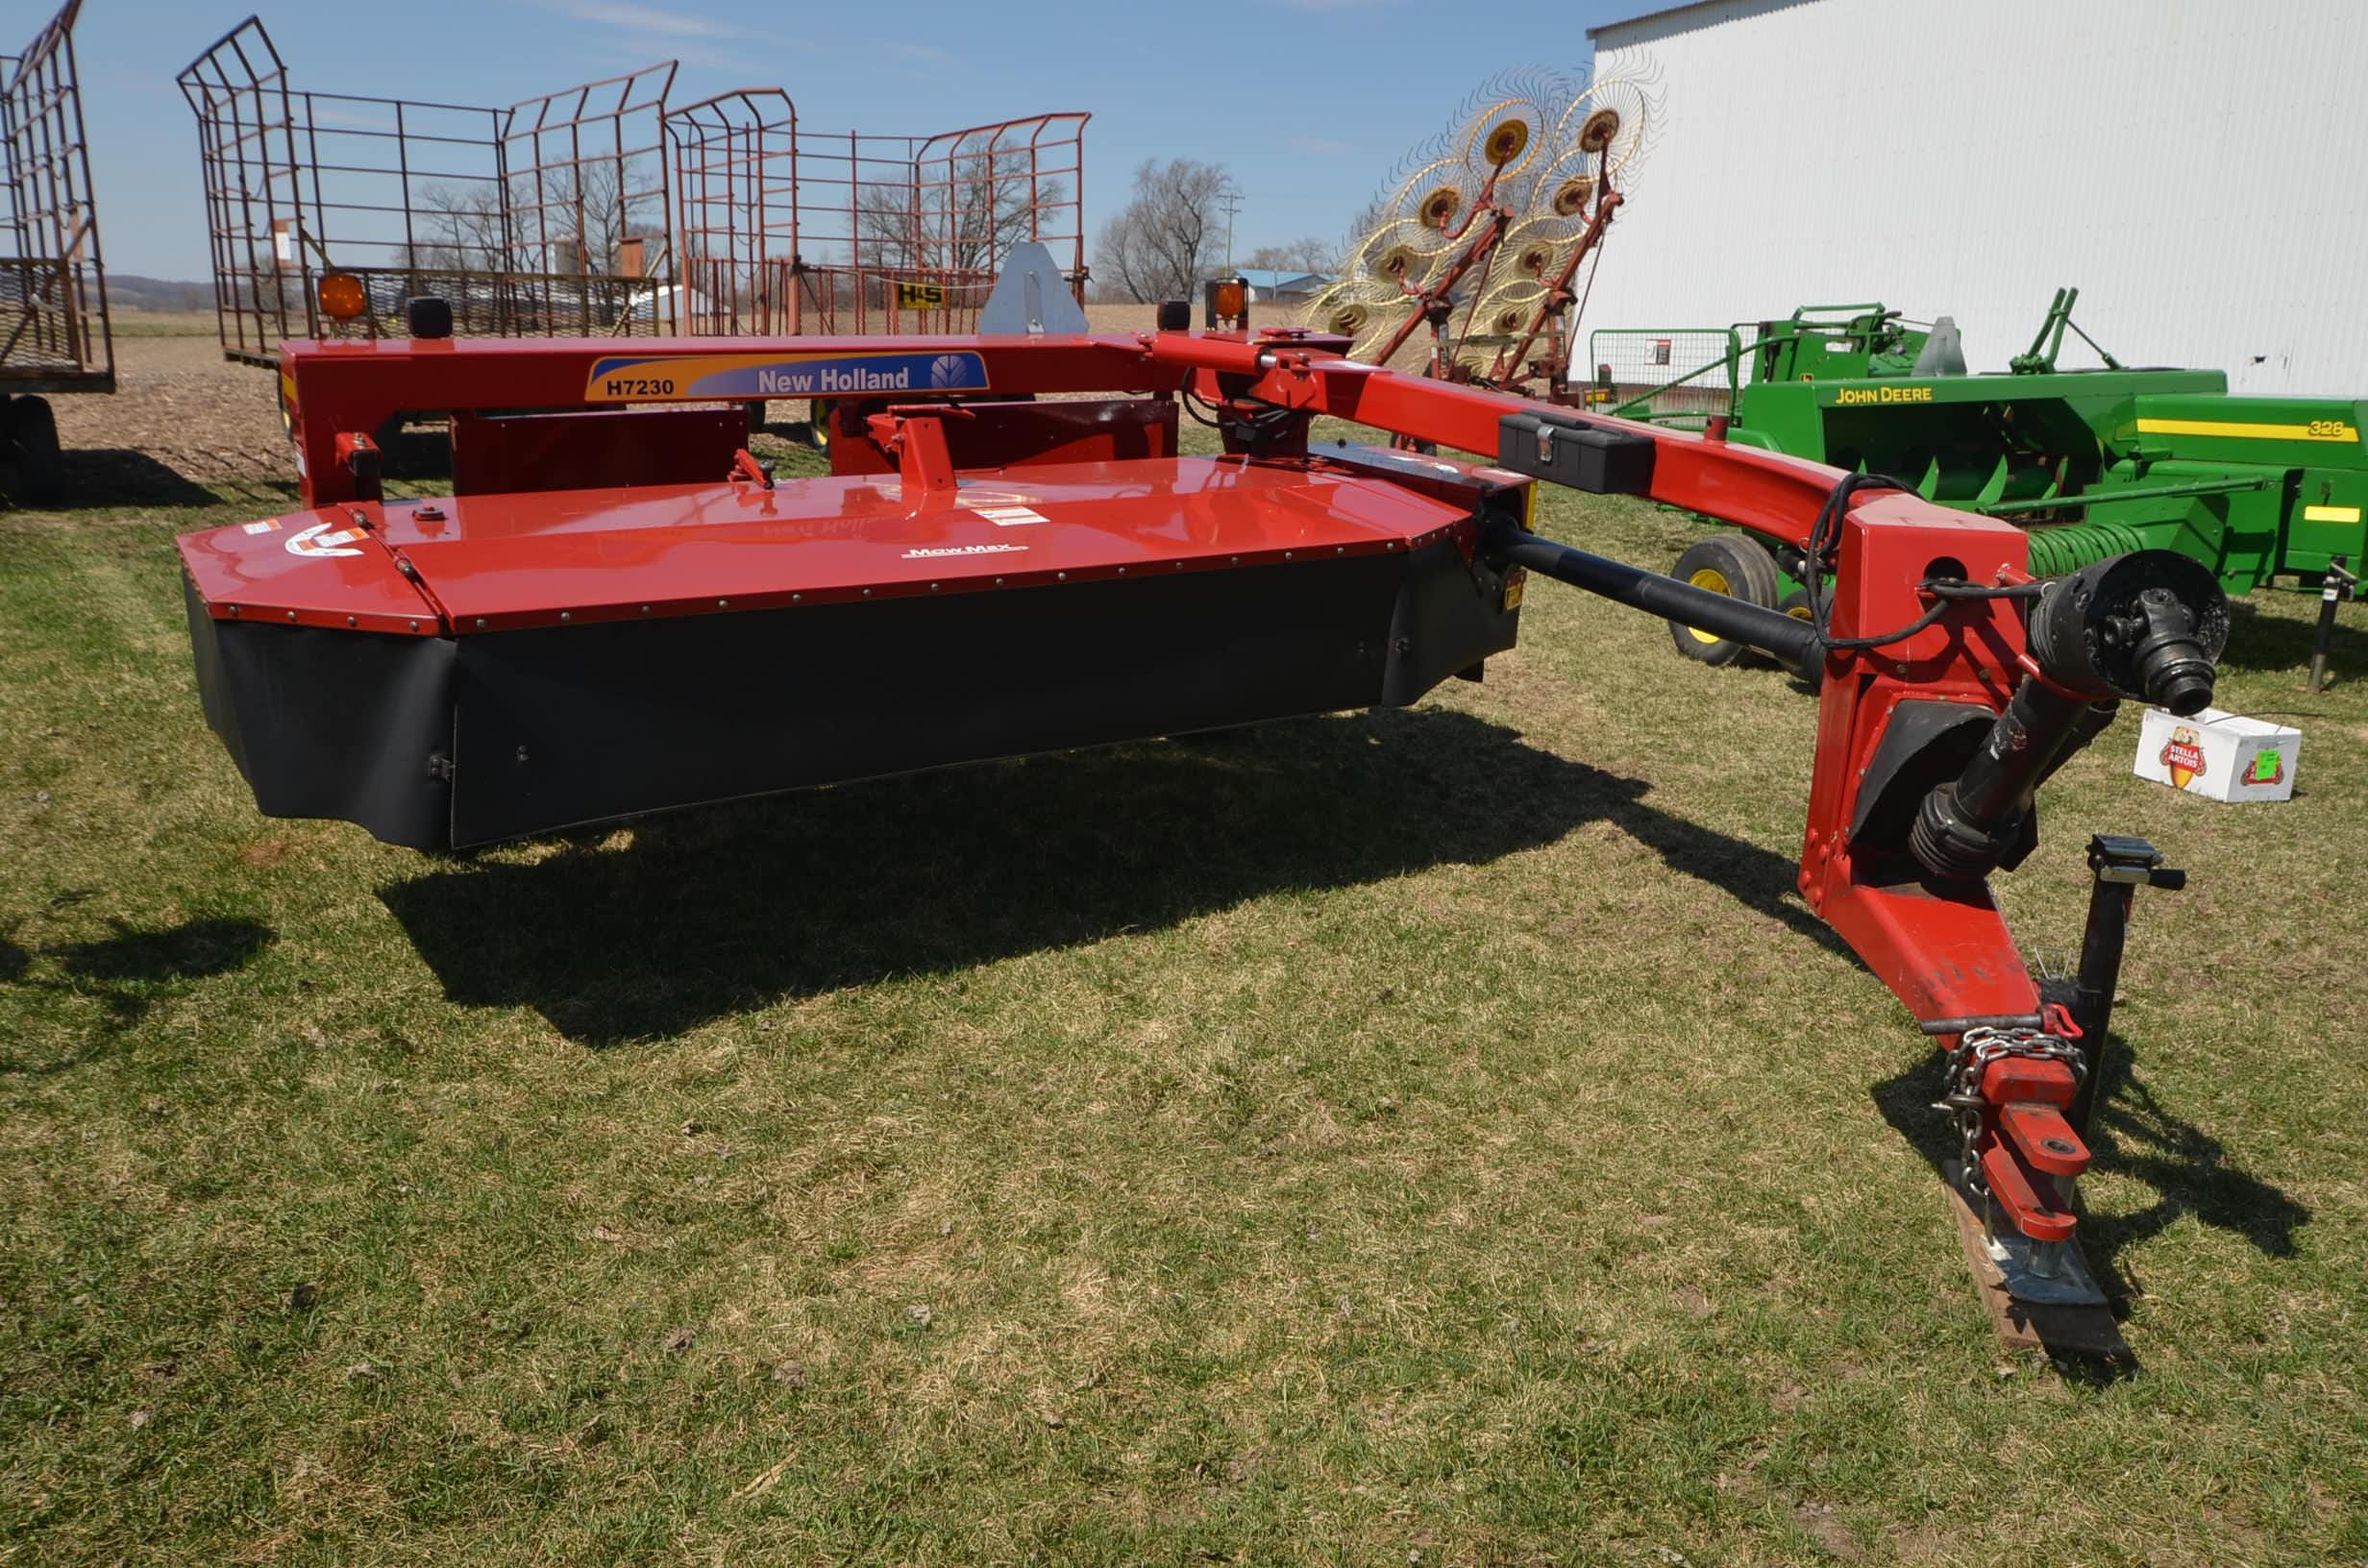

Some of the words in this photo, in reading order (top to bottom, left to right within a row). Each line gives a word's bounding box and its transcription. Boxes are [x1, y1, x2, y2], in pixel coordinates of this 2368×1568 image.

[899, 283, 942, 303] H&S
[606, 380, 675, 397] H7230
[758, 370, 813, 393] New
[821, 367, 909, 391] Holland
[1836, 387, 1878, 404] JOHN
[1881, 386, 1933, 402] DEERE
[2308, 420, 2345, 436] 328
[2169, 745, 2200, 760] STELLA
[2168, 754, 2199, 769] ARTOIS
